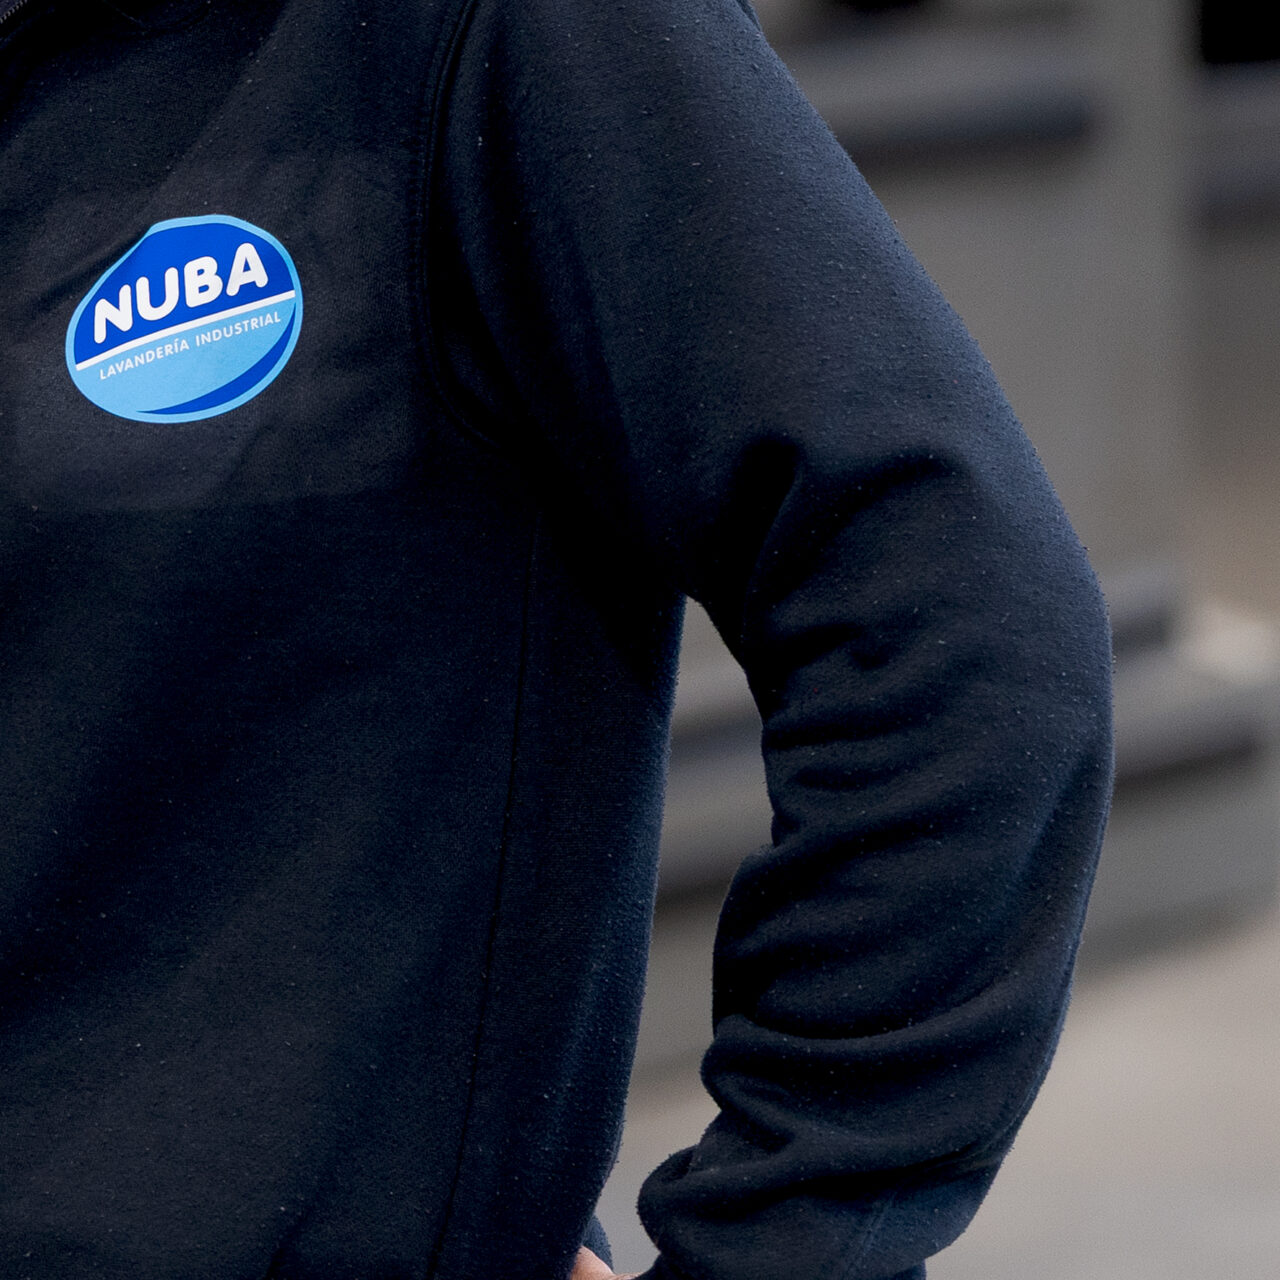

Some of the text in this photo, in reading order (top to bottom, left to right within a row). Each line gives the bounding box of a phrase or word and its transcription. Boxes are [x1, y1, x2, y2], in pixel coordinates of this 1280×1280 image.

[94, 242, 268, 344] NUBA
[99, 311, 281, 380] LAVANDERÍA INDUSTRIAL
